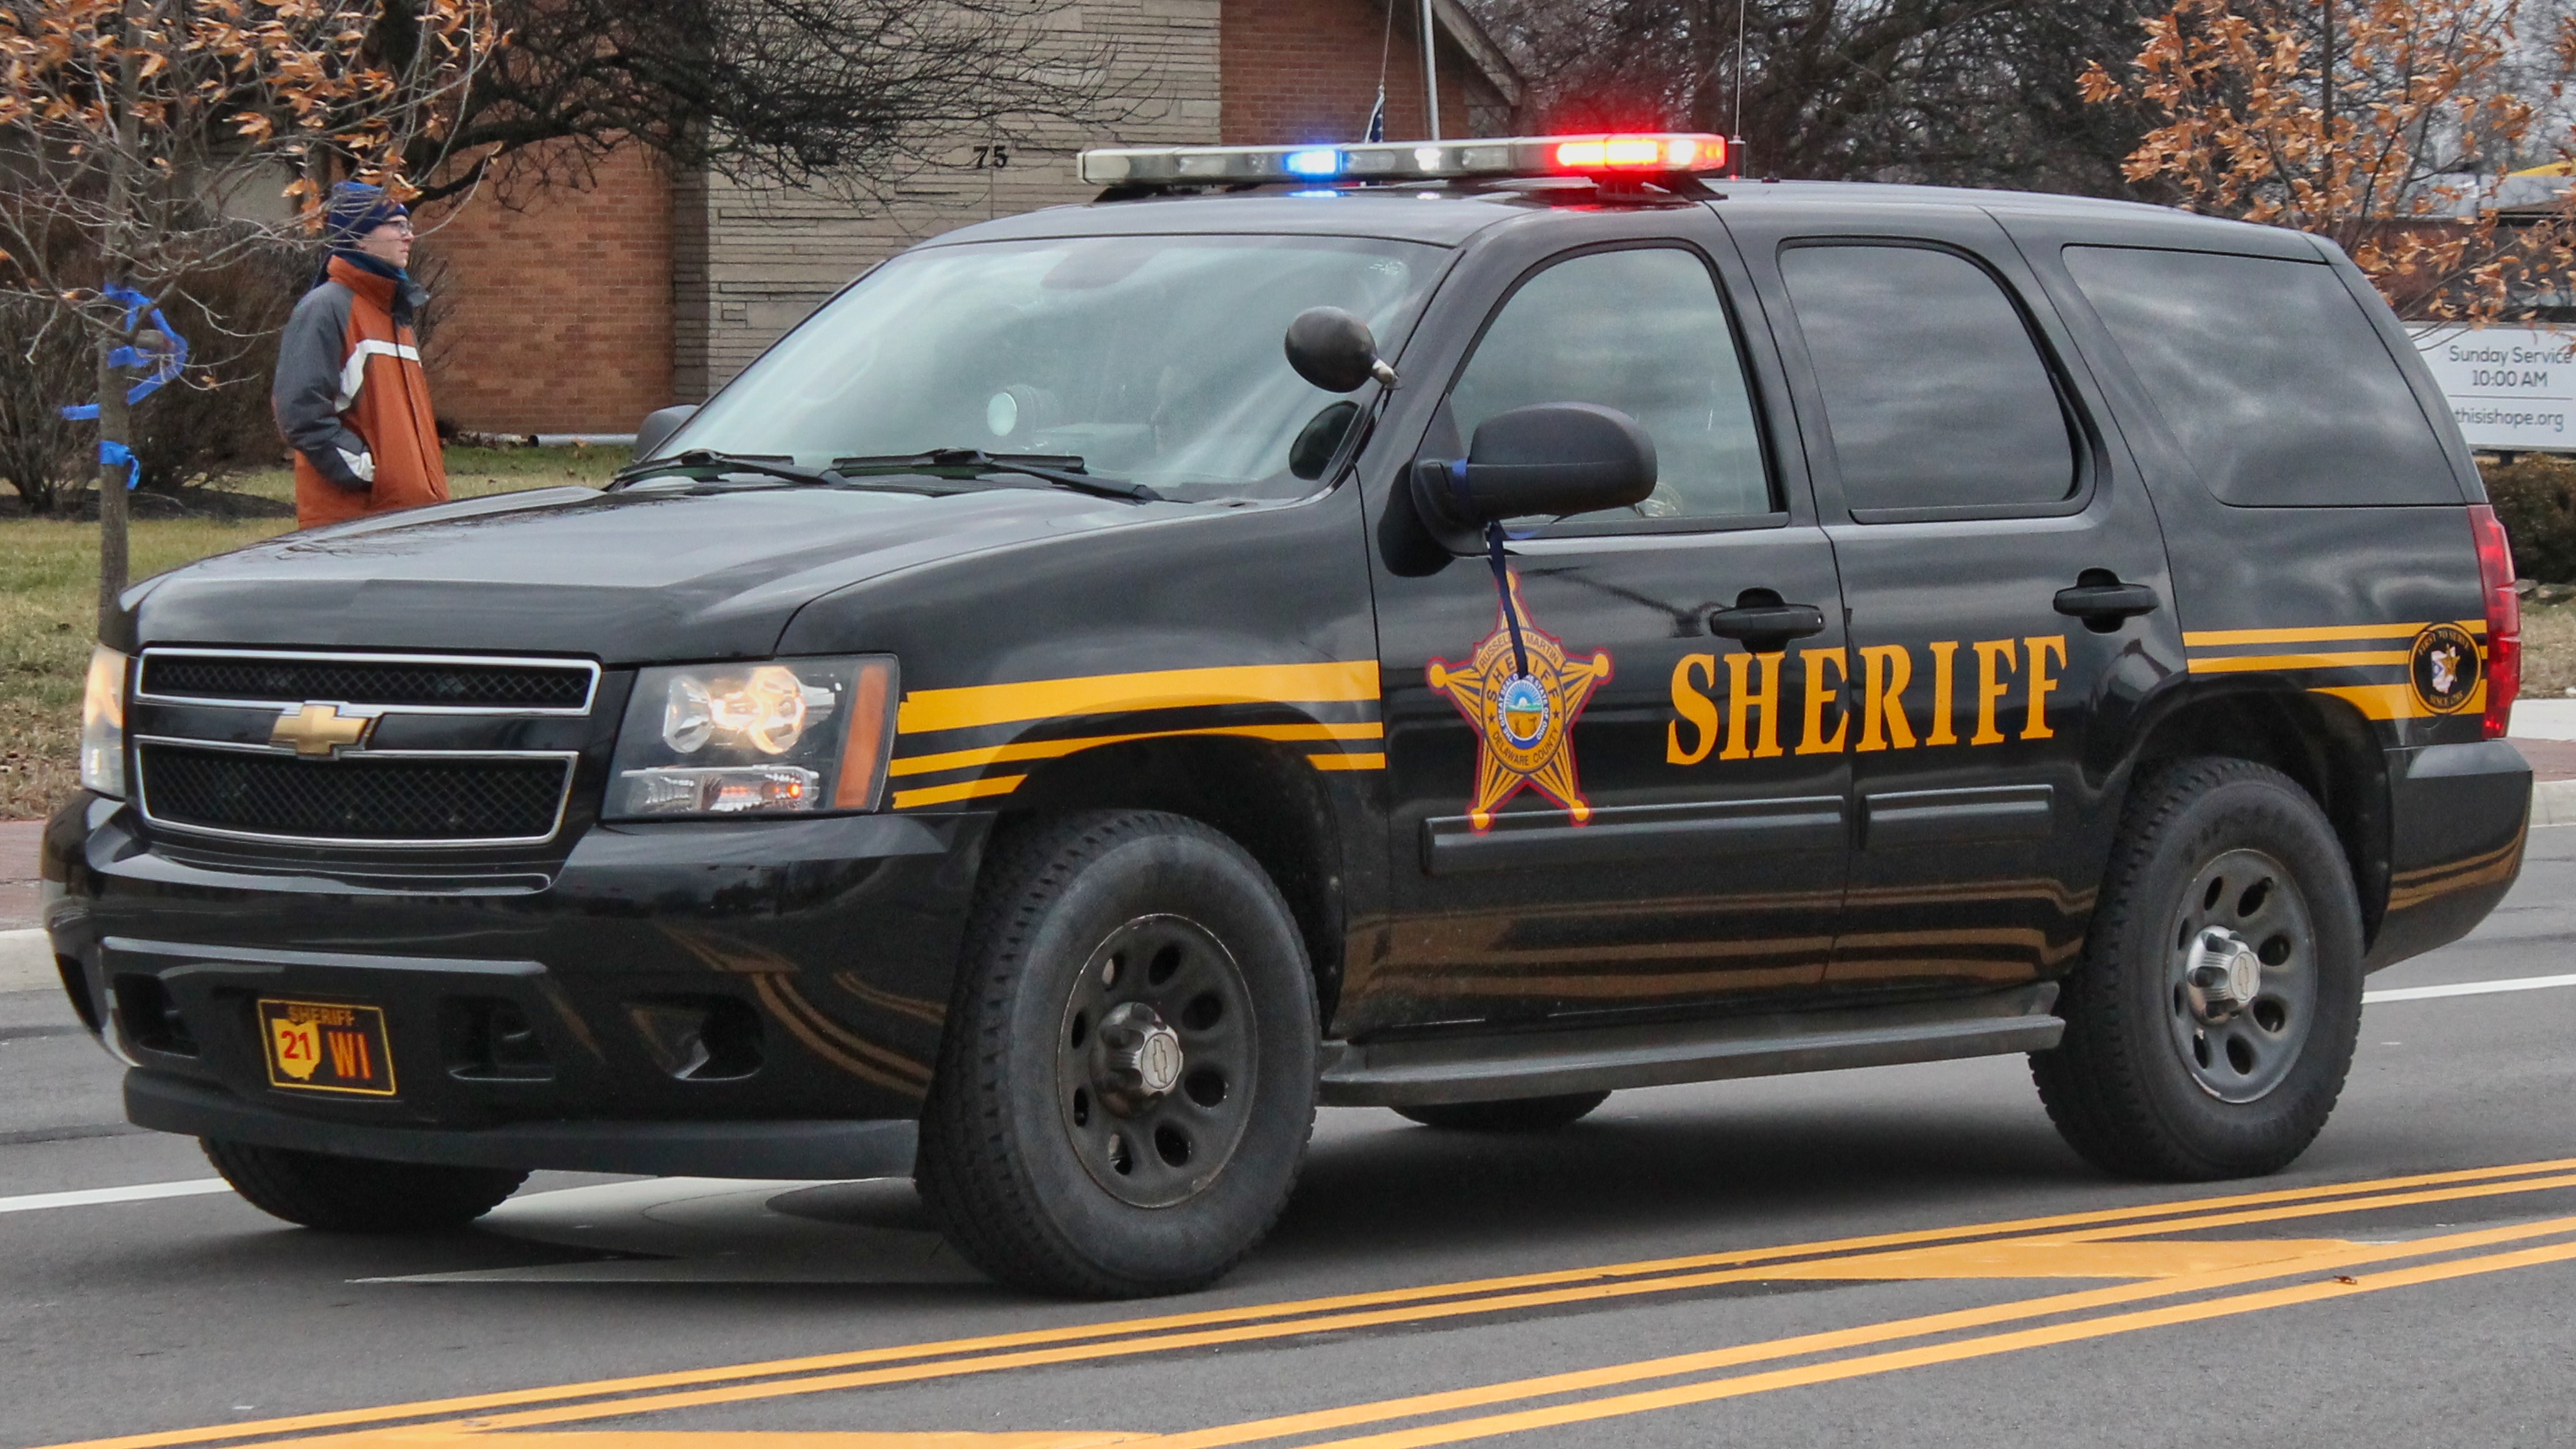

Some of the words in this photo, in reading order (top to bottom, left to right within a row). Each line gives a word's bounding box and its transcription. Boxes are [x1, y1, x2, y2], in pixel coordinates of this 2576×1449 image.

[973, 146, 1008, 168] 75
[2449, 345, 2509, 366] Sunday
[2512, 346, 2573, 364] Service
[2472, 370, 2517, 387] 10:00
[2521, 371, 2548, 387] AM
[2455, 408, 2564, 433] thisishope.org
[1526, 633, 1559, 663] MARTIN
[1486, 656, 1560, 702] SHEIFF
[1667, 635, 2068, 765] SHERIFF
[1492, 731, 1529, 766] DELAWARE
[1533, 727, 1559, 763] COUNTY
[287, 1005, 355, 1026] SHERIFF
[280, 1031, 312, 1061] 21
